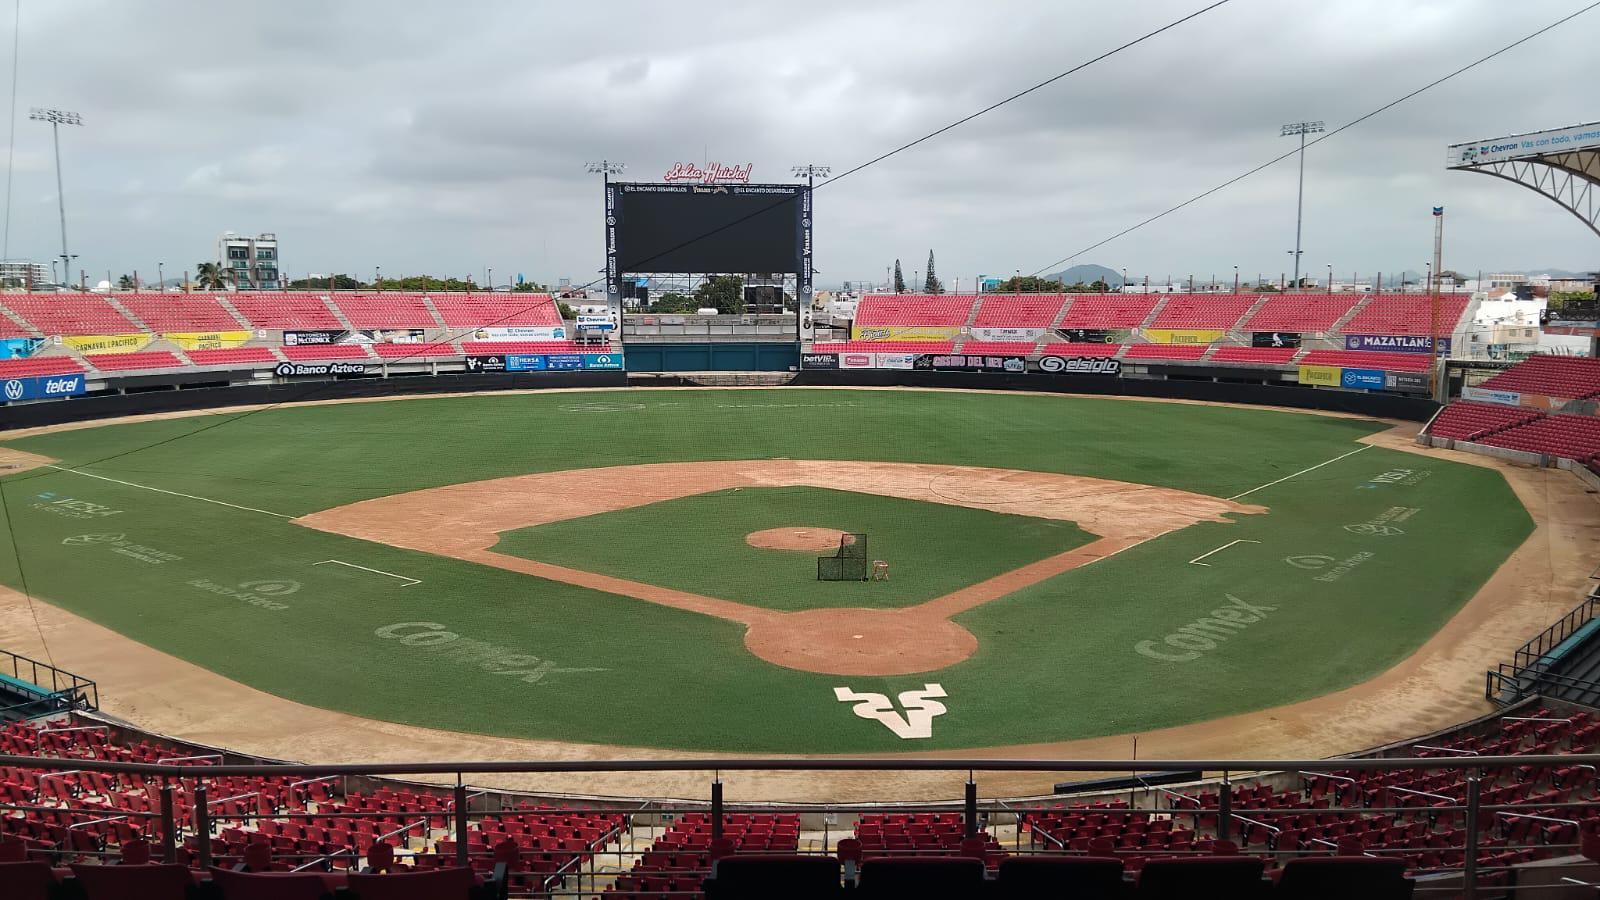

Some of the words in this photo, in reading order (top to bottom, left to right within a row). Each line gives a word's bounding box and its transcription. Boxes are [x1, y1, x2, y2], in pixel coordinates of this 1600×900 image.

[1491, 142, 1518, 153] Chevron
[1521, 140, 1534, 149] Vas
[1536, 138, 1549, 147] con
[664, 162, 702, 181] Salsa
[702, 161, 752, 183] Huichol
[1364, 336, 1424, 348] MAZATLÁN
[967, 356, 985, 367] DEL
[1065, 358, 1119, 373] elsiglo
[296, 365, 328, 375] Banco
[329, 364, 364, 374] Azteca
[45, 378, 79, 394] telcel
